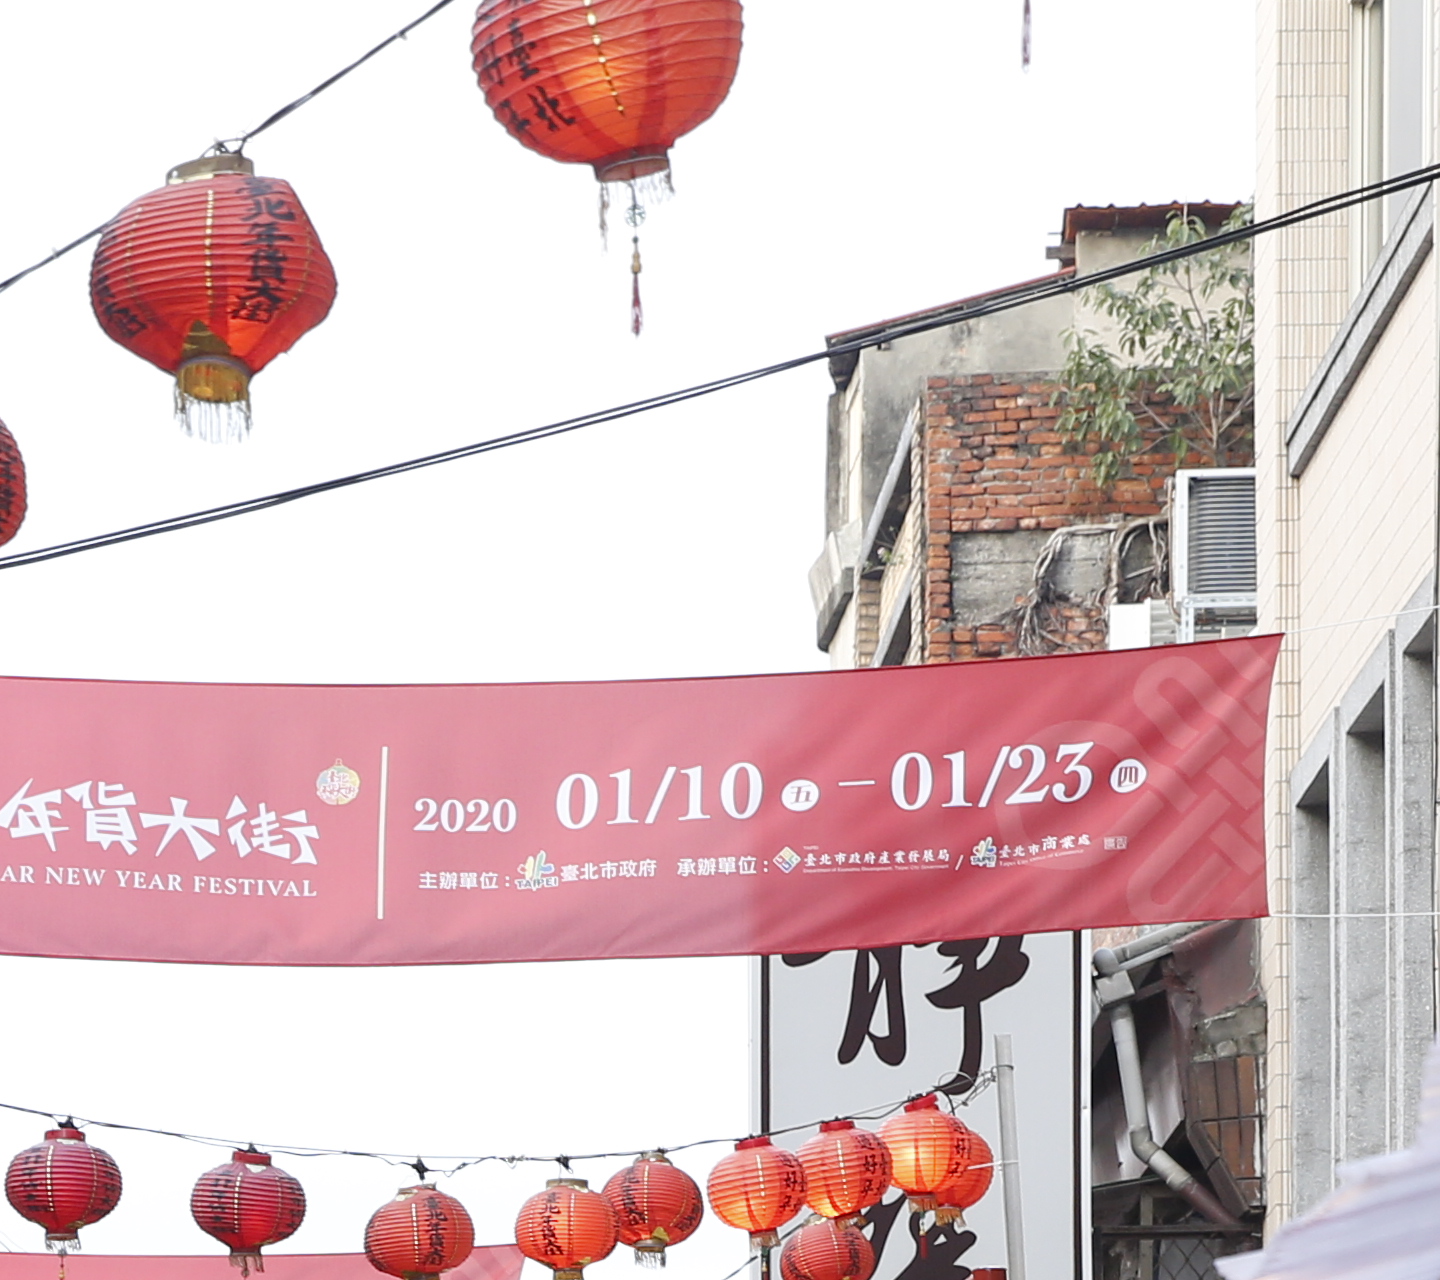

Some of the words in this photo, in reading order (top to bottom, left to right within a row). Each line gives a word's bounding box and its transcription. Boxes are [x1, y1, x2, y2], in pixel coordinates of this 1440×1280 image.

[413, 797, 518, 833] 2020
[555, 761, 764, 830] 01/10
[890, 741, 1095, 812] 01/23
[45, 866, 106, 887] NEW
[117, 869, 183, 892] YEAR
[192, 874, 317, 898] FESTIVAL
